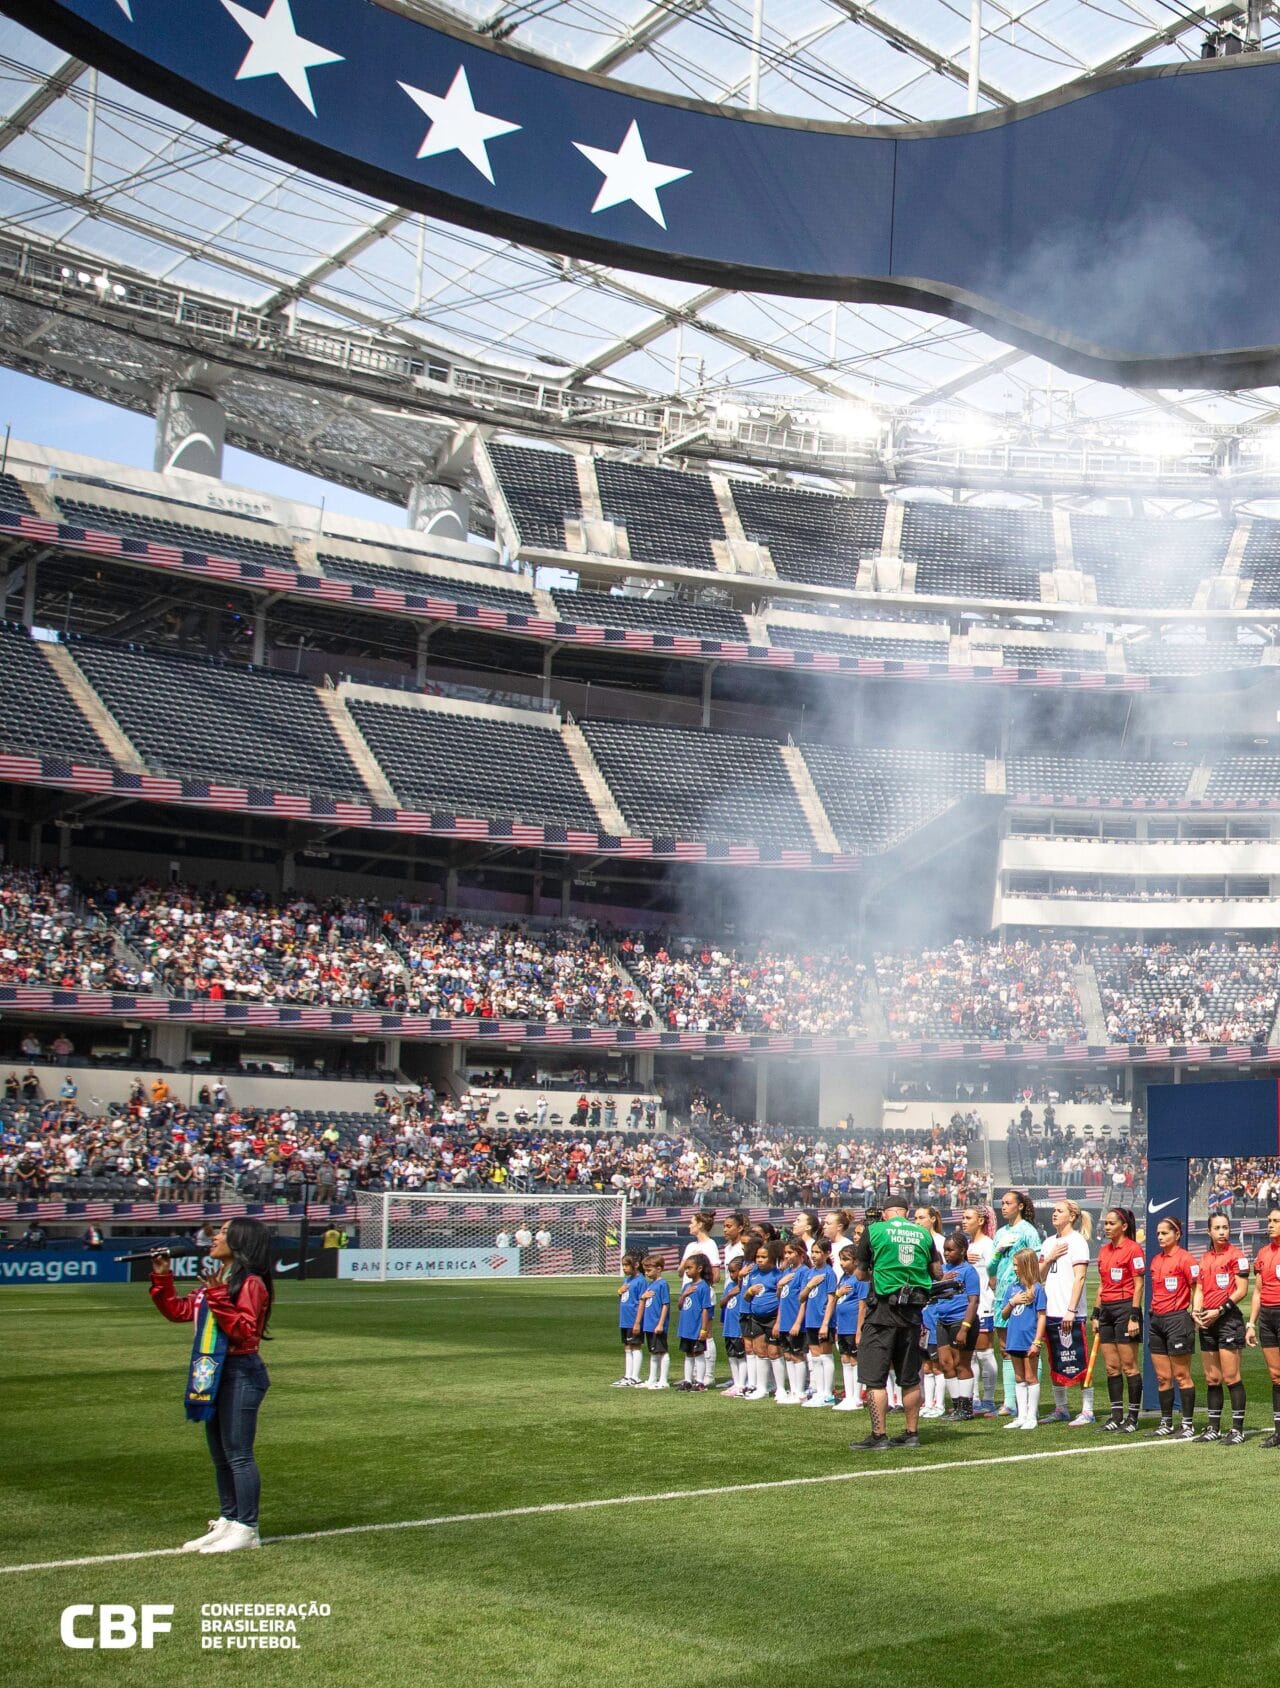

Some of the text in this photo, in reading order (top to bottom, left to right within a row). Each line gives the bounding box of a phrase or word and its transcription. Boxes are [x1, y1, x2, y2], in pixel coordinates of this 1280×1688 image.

[891, 1235, 920, 1245] HOLDER
[0, 1259, 97, 1282] wagen
[169, 1255, 199, 1276] IKE
[395, 1261, 413, 1271] OF
[415, 1260, 477, 1271] AMERICA
